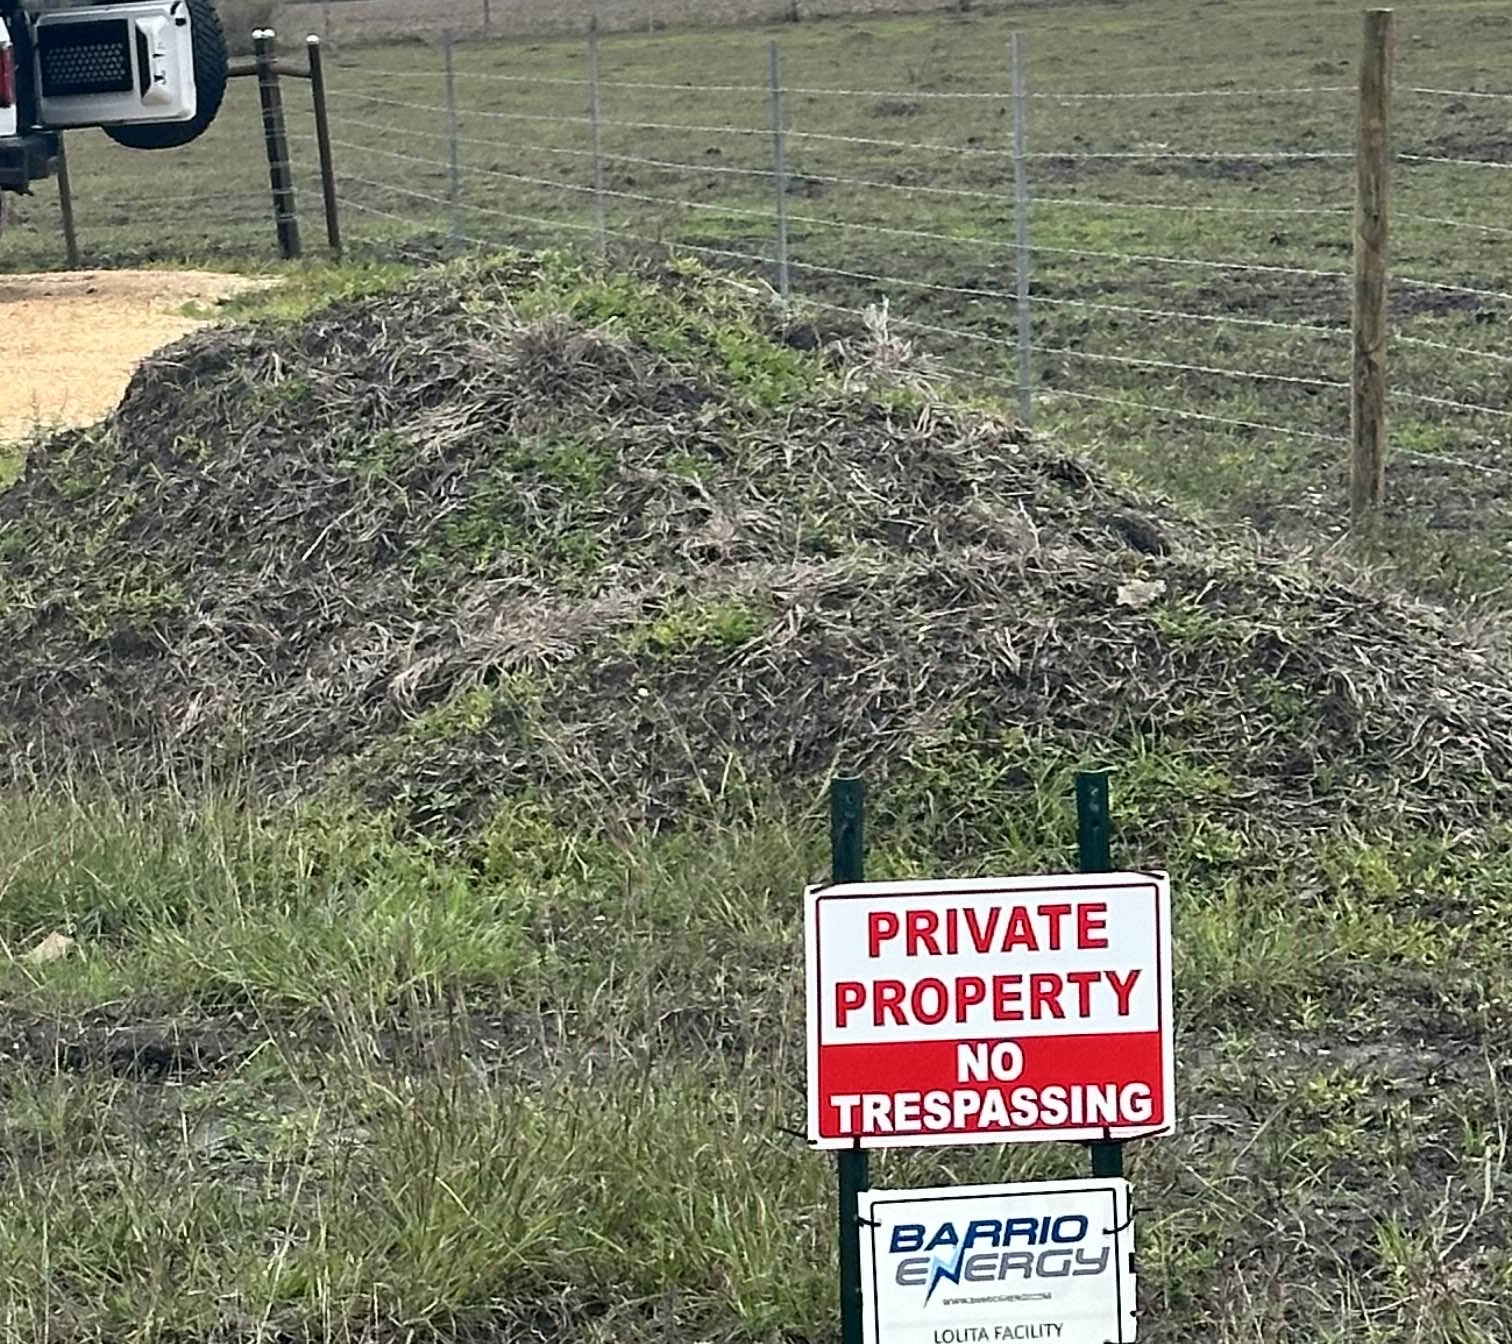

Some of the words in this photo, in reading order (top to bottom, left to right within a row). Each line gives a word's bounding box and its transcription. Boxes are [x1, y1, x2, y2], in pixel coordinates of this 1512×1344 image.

[868, 903, 1109, 958] PRIVATE
[835, 969, 1142, 1028] PROPERTY
[957, 1042, 1024, 1083] NO
[830, 1083, 1153, 1134] TRESPASSING
[889, 1215, 1088, 1253] BARRIO
[895, 1247, 1110, 1307] ENERGY
[934, 1327, 989, 1344] LOLITA
[994, 1323, 1064, 1341] FACILITY
